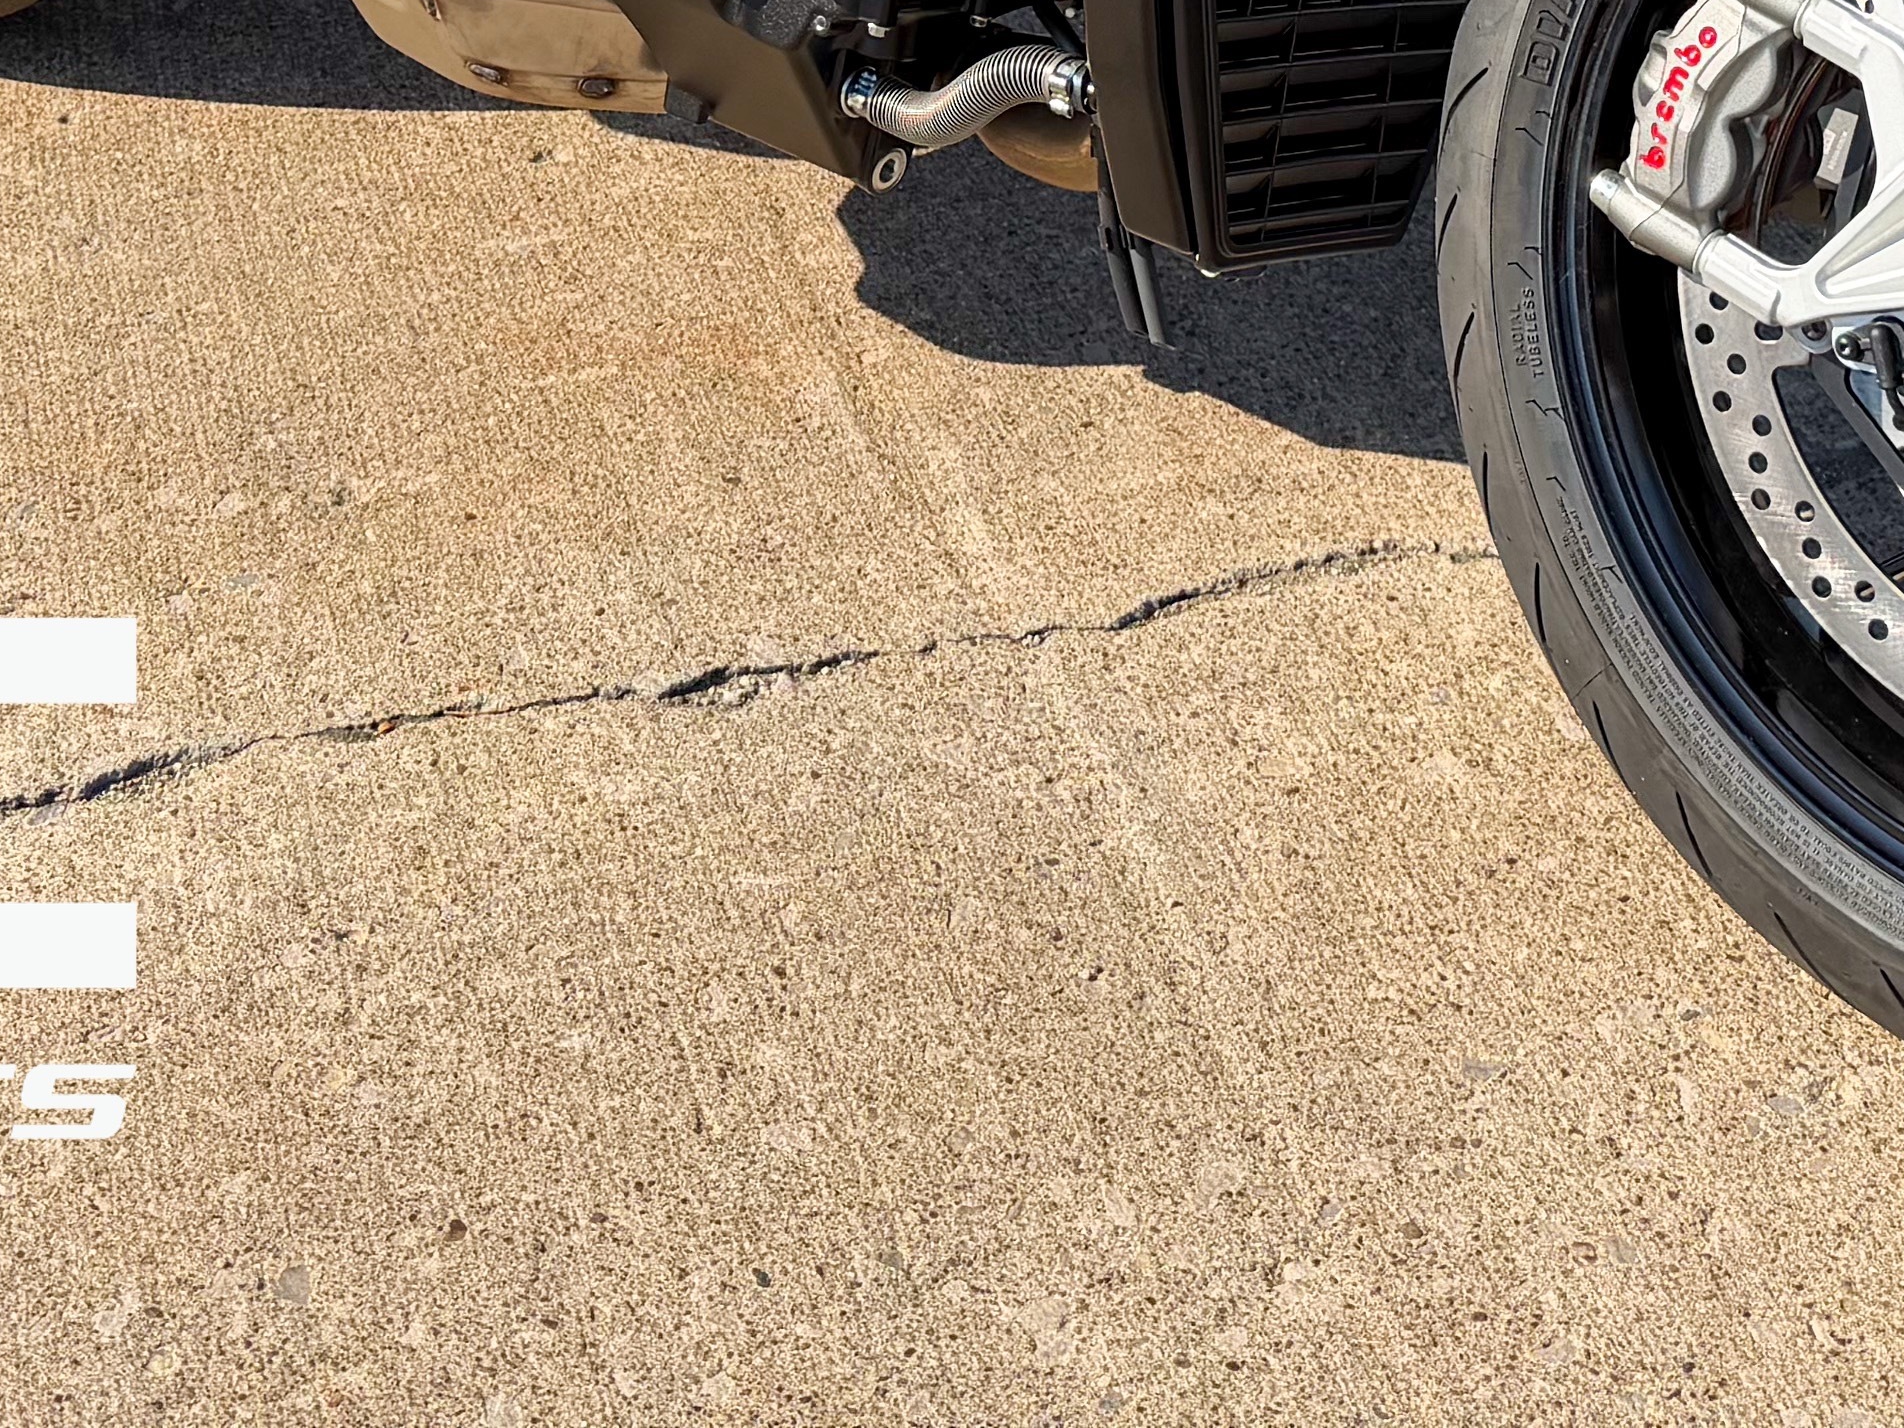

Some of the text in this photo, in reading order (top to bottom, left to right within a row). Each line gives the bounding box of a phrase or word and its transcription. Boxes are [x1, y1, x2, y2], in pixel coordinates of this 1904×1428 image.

[1639, 25, 1718, 170] brembo
[1509, 302, 1528, 367] RADIAL
[1522, 286, 1545, 379] TUBELESS
